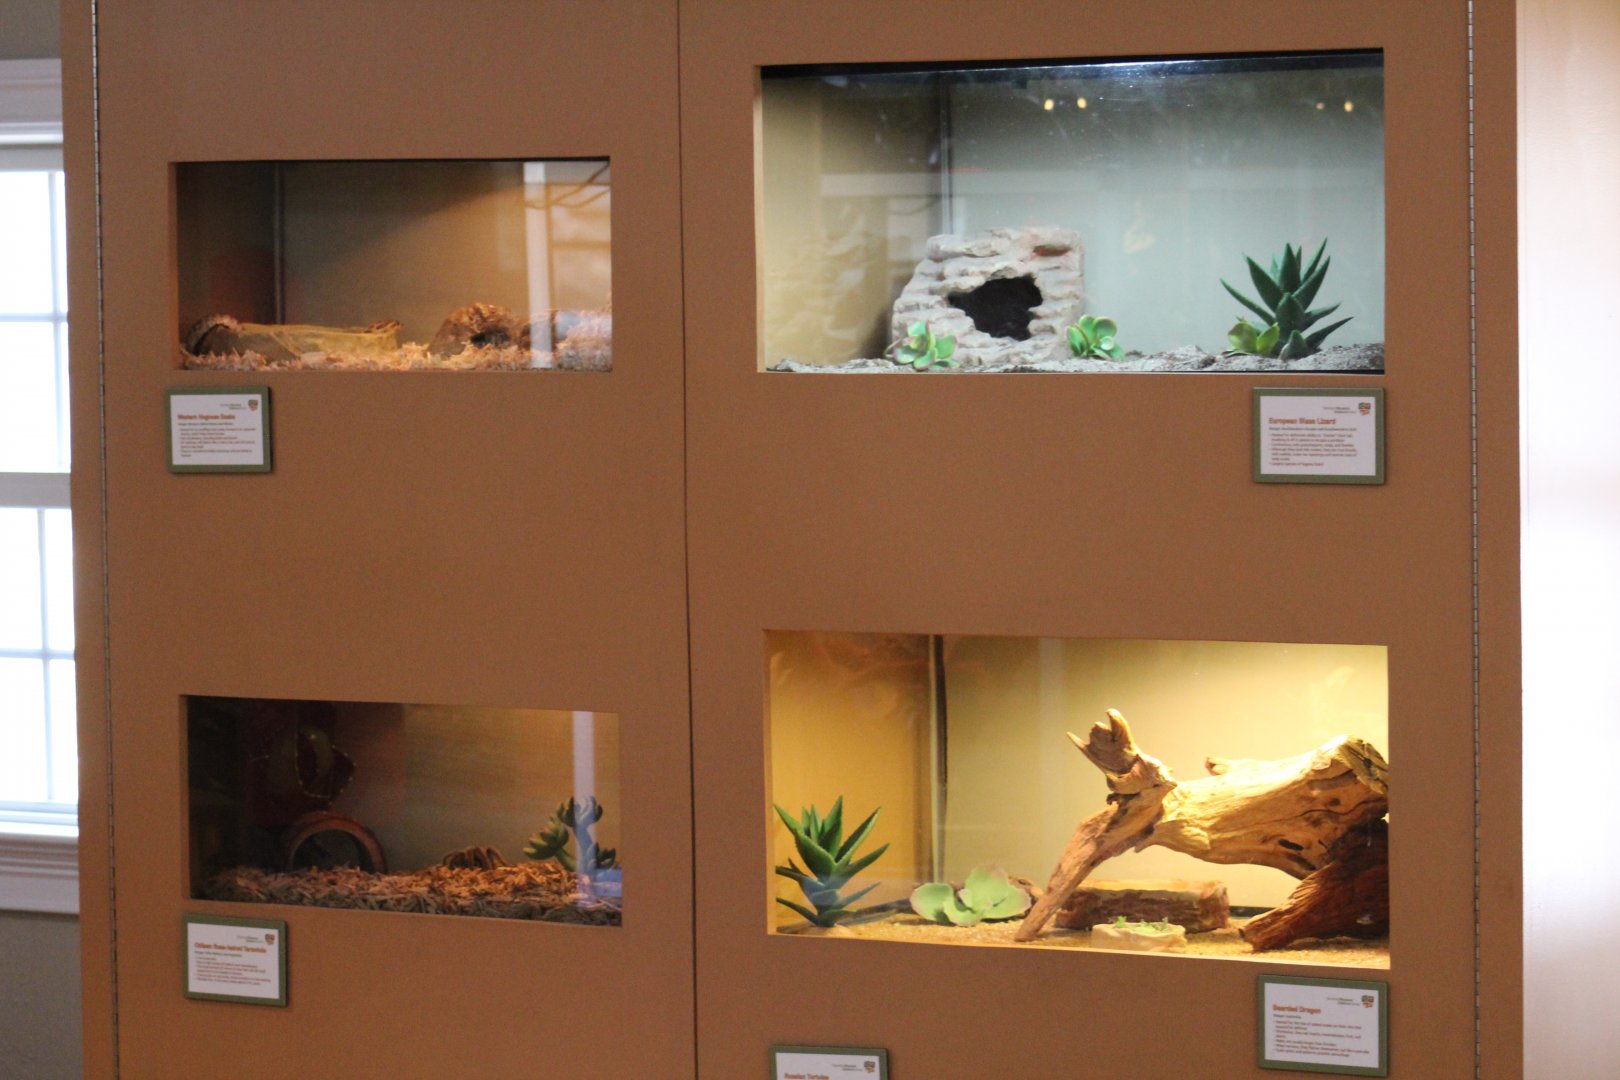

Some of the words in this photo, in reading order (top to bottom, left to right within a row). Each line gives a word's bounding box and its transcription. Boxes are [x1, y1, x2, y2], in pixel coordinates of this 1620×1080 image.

[1269, 417, 1297, 425] European
[1273, 1004, 1298, 1012] Bearded
[1300, 1006, 1321, 1015] Dragon
